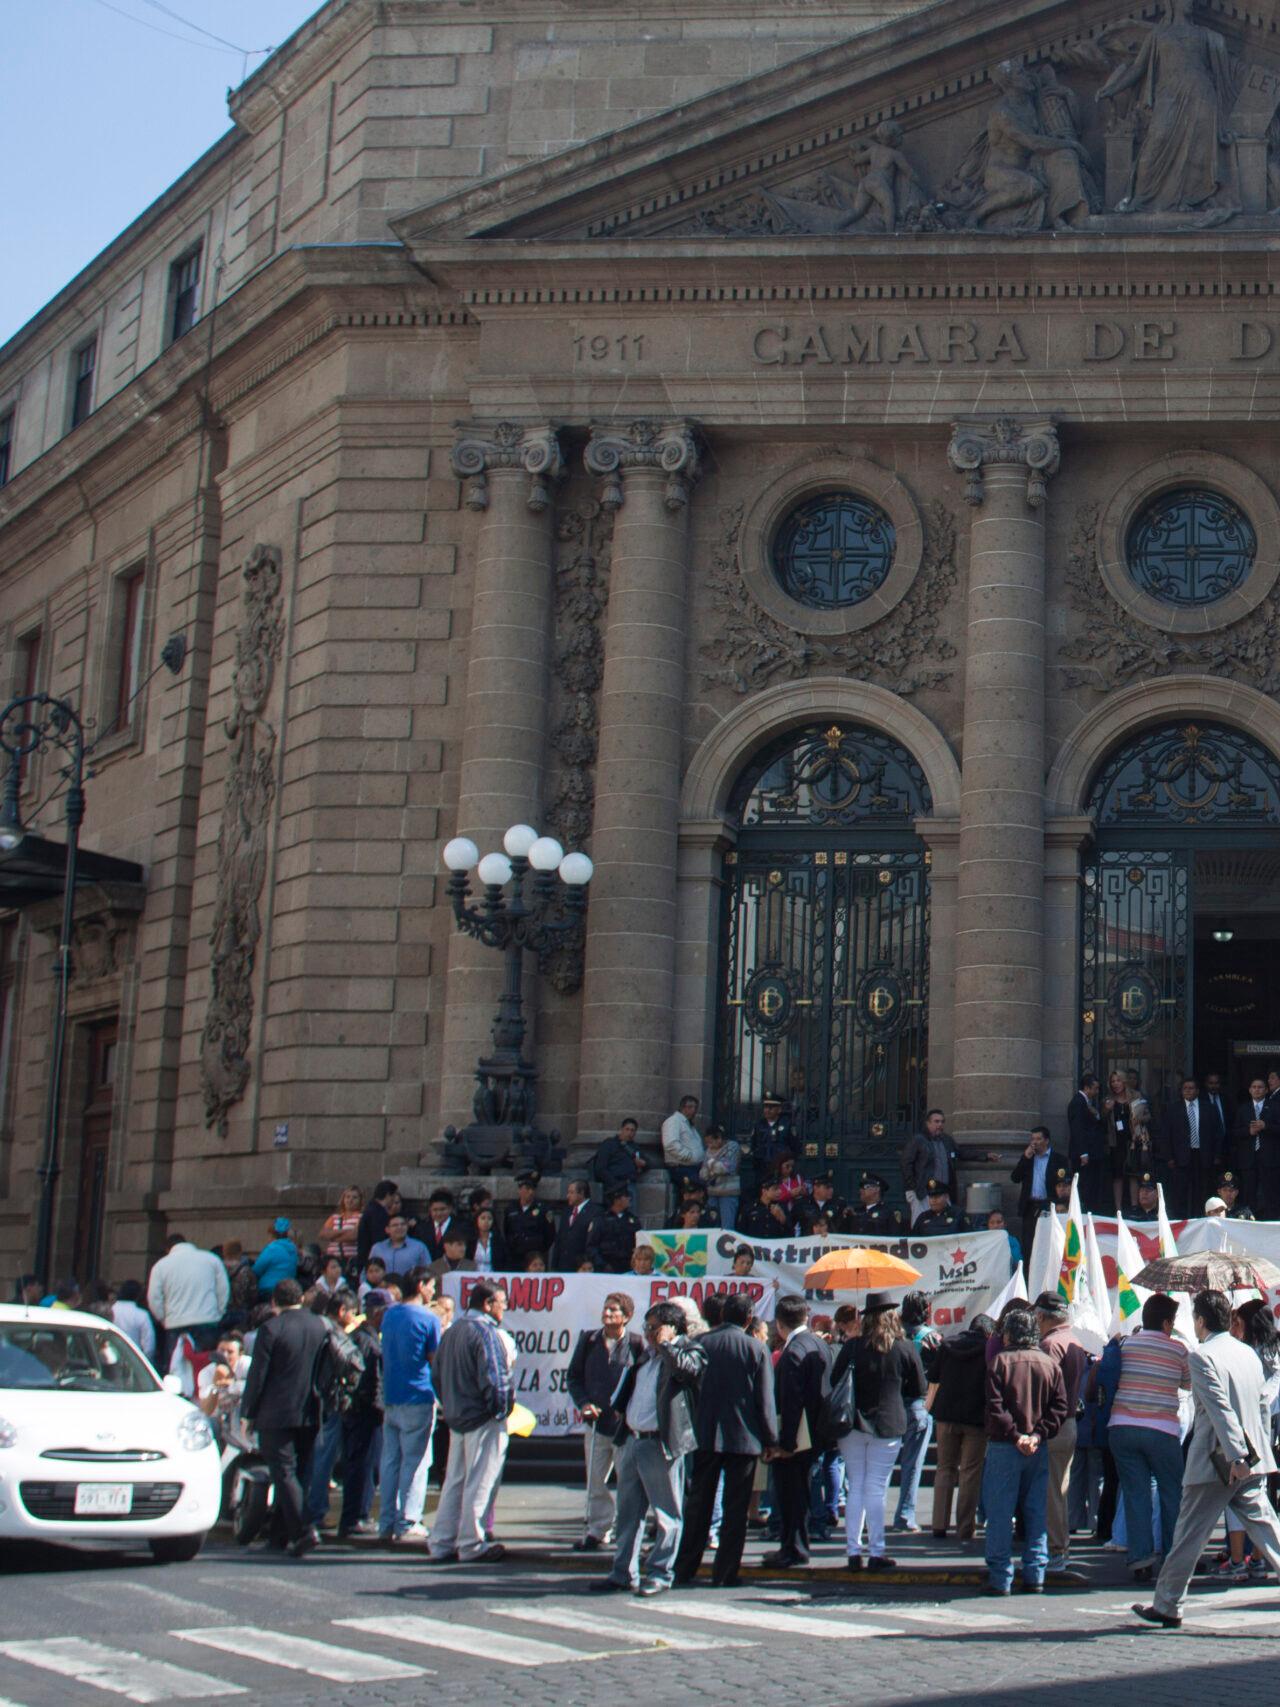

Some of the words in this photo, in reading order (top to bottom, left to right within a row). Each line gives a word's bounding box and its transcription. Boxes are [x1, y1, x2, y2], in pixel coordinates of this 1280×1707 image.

[573, 333, 645, 361] 1911
[752, 322, 1029, 365] CAMARA
[1084, 318, 1178, 361] DE
[518, 1369, 540, 1392] LA
[554, 1407, 569, 1426] del
